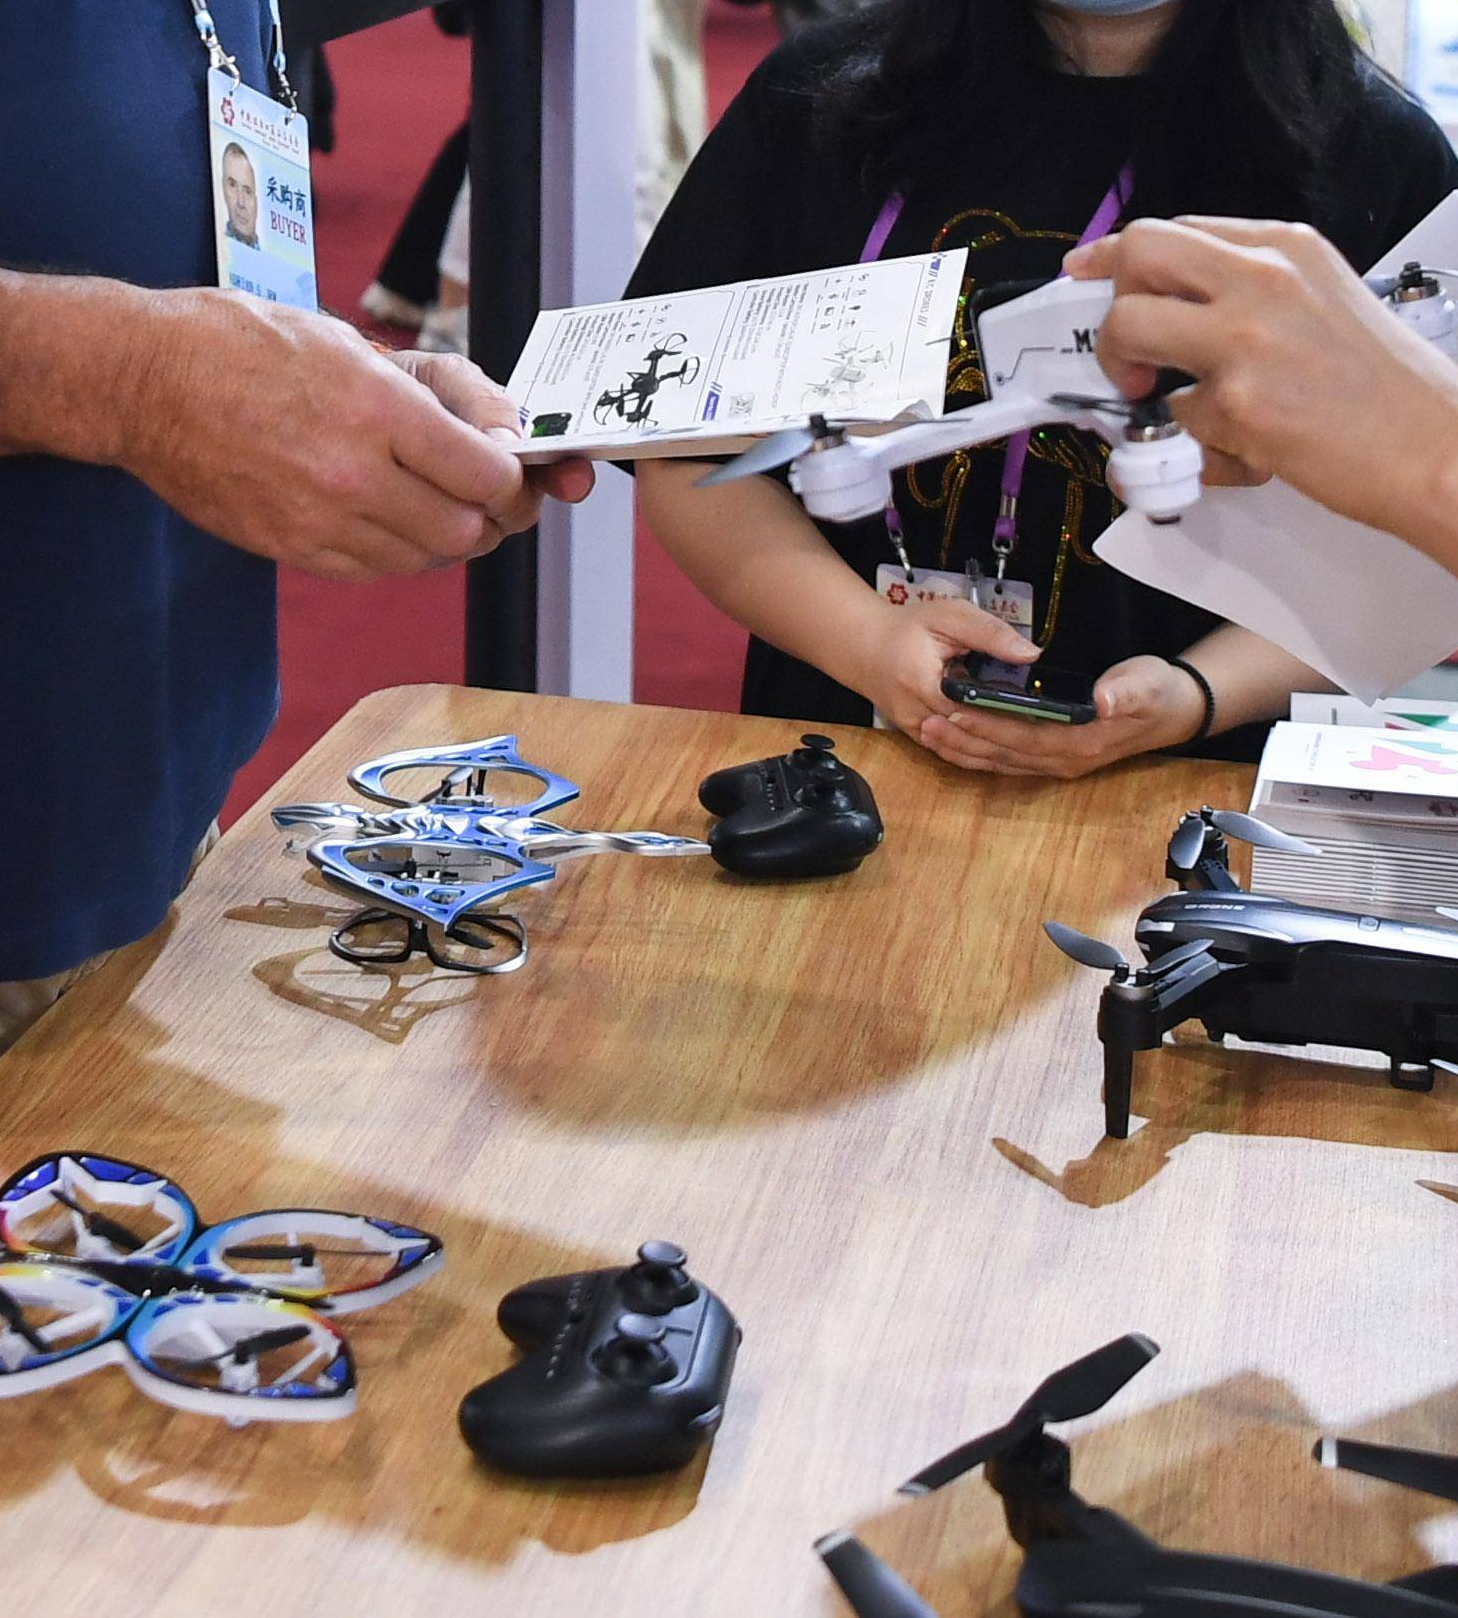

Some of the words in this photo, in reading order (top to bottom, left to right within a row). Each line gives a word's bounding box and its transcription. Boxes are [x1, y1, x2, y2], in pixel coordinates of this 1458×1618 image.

[266, 176, 307, 218] 采购商
[270, 210, 308, 245] BUYER
[1183, 903, 1246, 911] DRONE
